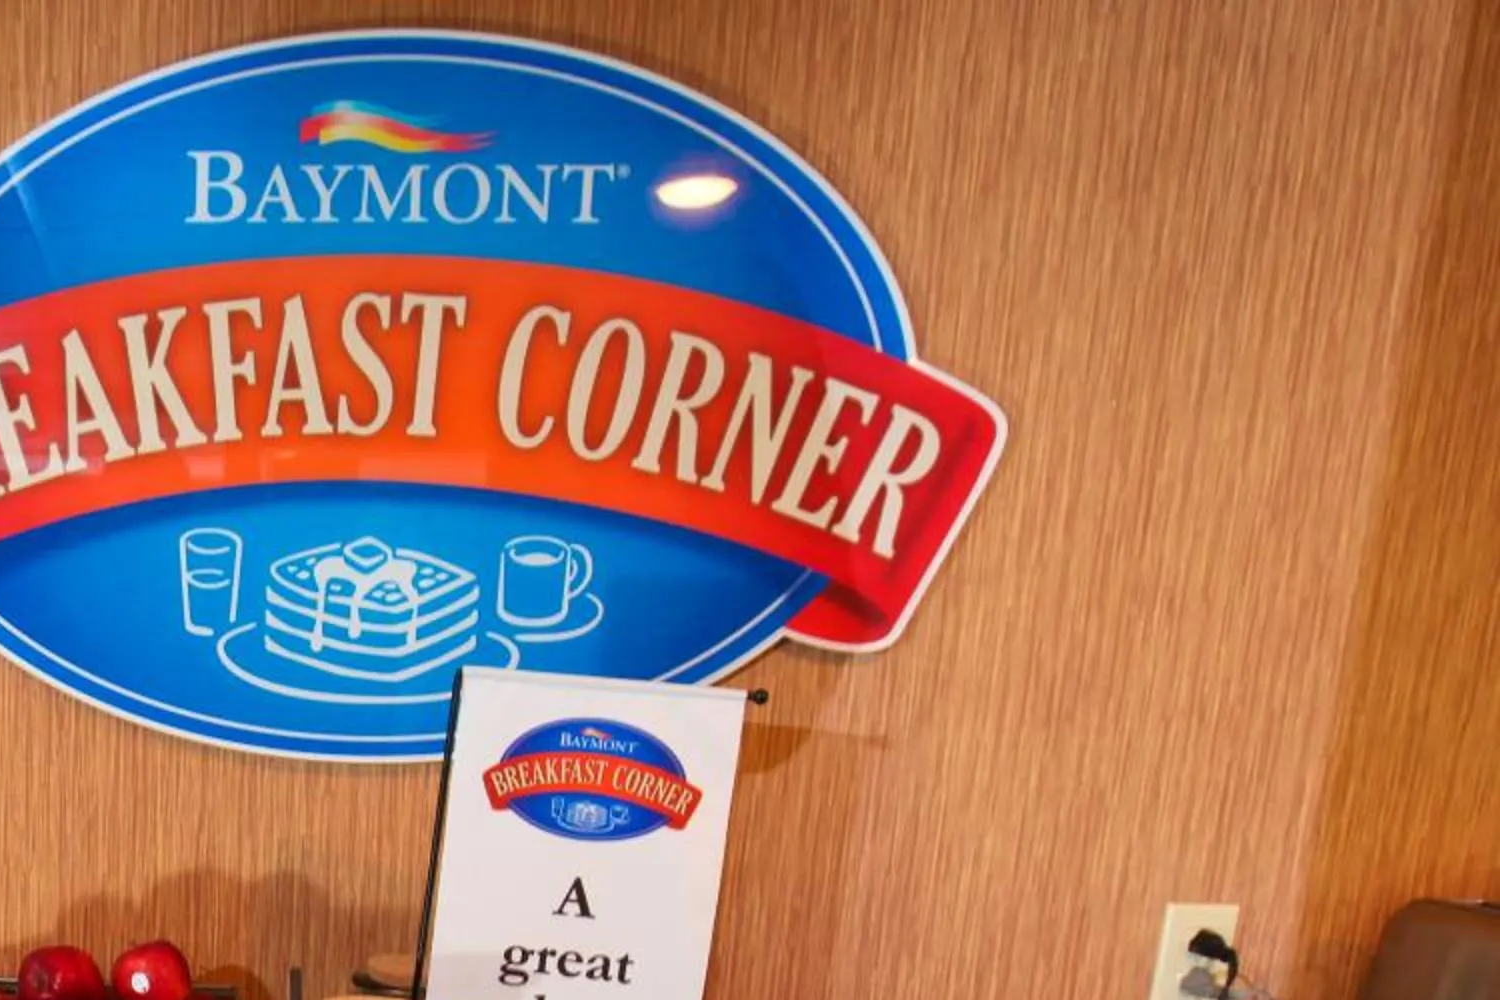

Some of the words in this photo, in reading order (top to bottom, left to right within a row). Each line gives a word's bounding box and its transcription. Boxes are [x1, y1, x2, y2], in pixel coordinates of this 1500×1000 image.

[497, 301, 942, 562] CORNER
[559, 731, 638, 754] BAYMONT
[490, 756, 609, 798] BREAKFAST
[611, 764, 694, 817] CORNER
[552, 875, 596, 920] A
[498, 943, 635, 987] great
